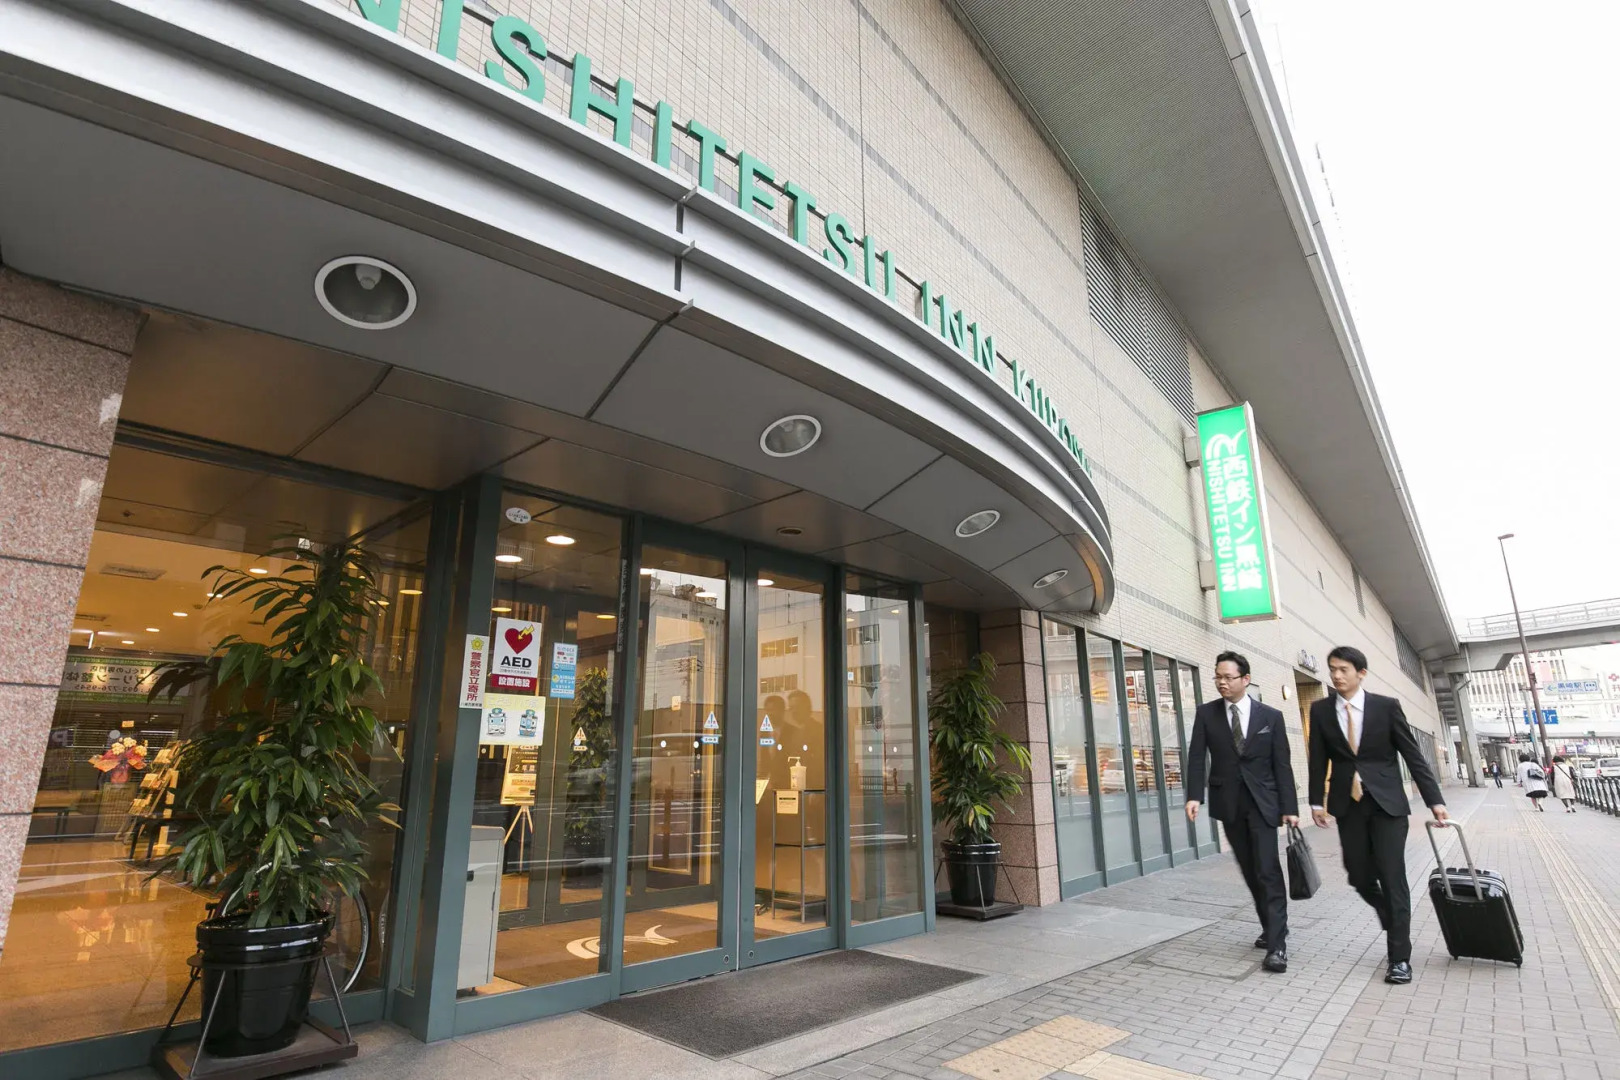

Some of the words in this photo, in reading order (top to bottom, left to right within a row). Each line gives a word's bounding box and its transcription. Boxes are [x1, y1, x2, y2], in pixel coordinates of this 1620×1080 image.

[919, 280, 998, 378] INN
[1205, 459, 1234, 560] NISHITETSU
[1219, 562, 1238, 593] INN
[500, 655, 532, 668] AED
